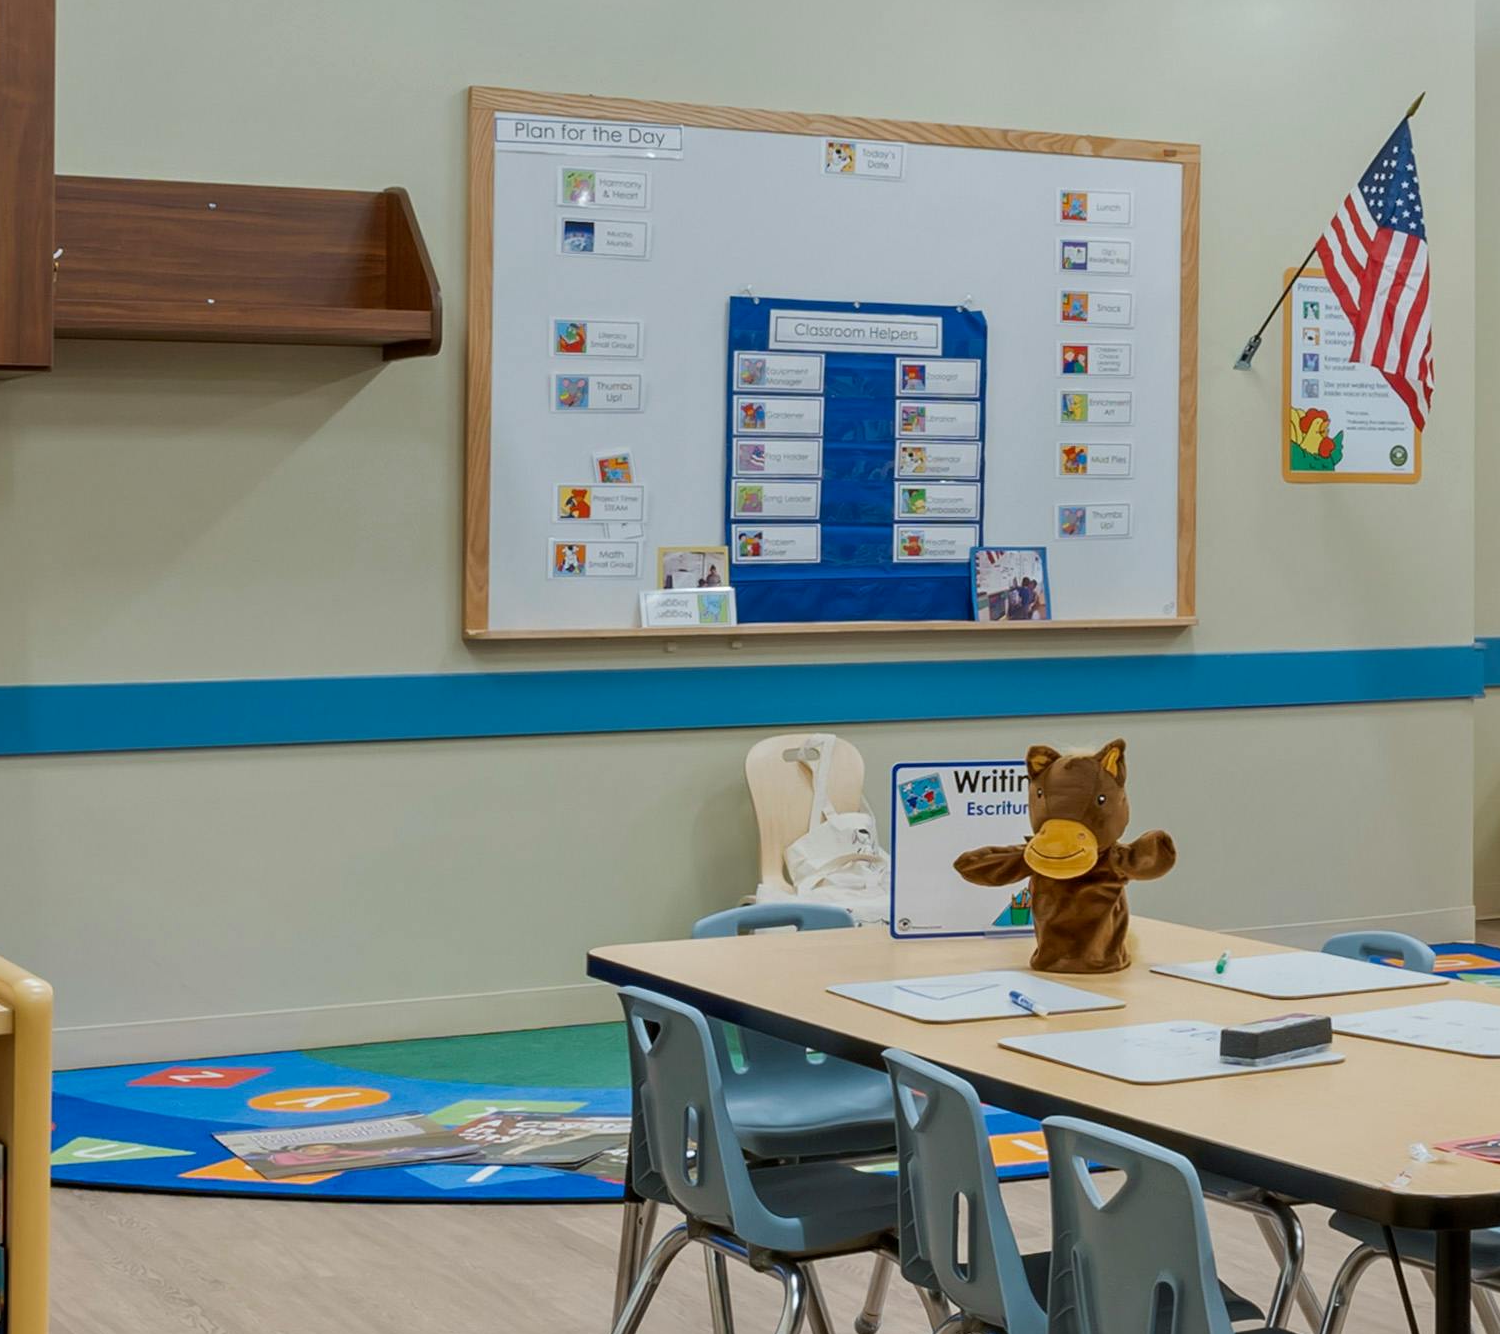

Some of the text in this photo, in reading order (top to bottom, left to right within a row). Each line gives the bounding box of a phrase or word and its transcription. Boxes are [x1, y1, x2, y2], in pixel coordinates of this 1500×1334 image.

[515, 122, 666, 147] Plan for the Day
[600, 178, 642, 190] Harmony
[612, 190, 639, 200] Heart
[795, 323, 918, 342] Classroom Helpers
[596, 381, 633, 391] Thumbs
[606, 392, 622, 404] Up!
[599, 550, 624, 560] Math
[954, 769, 1031, 793] Writin
[967, 800, 1029, 816] Escritur
